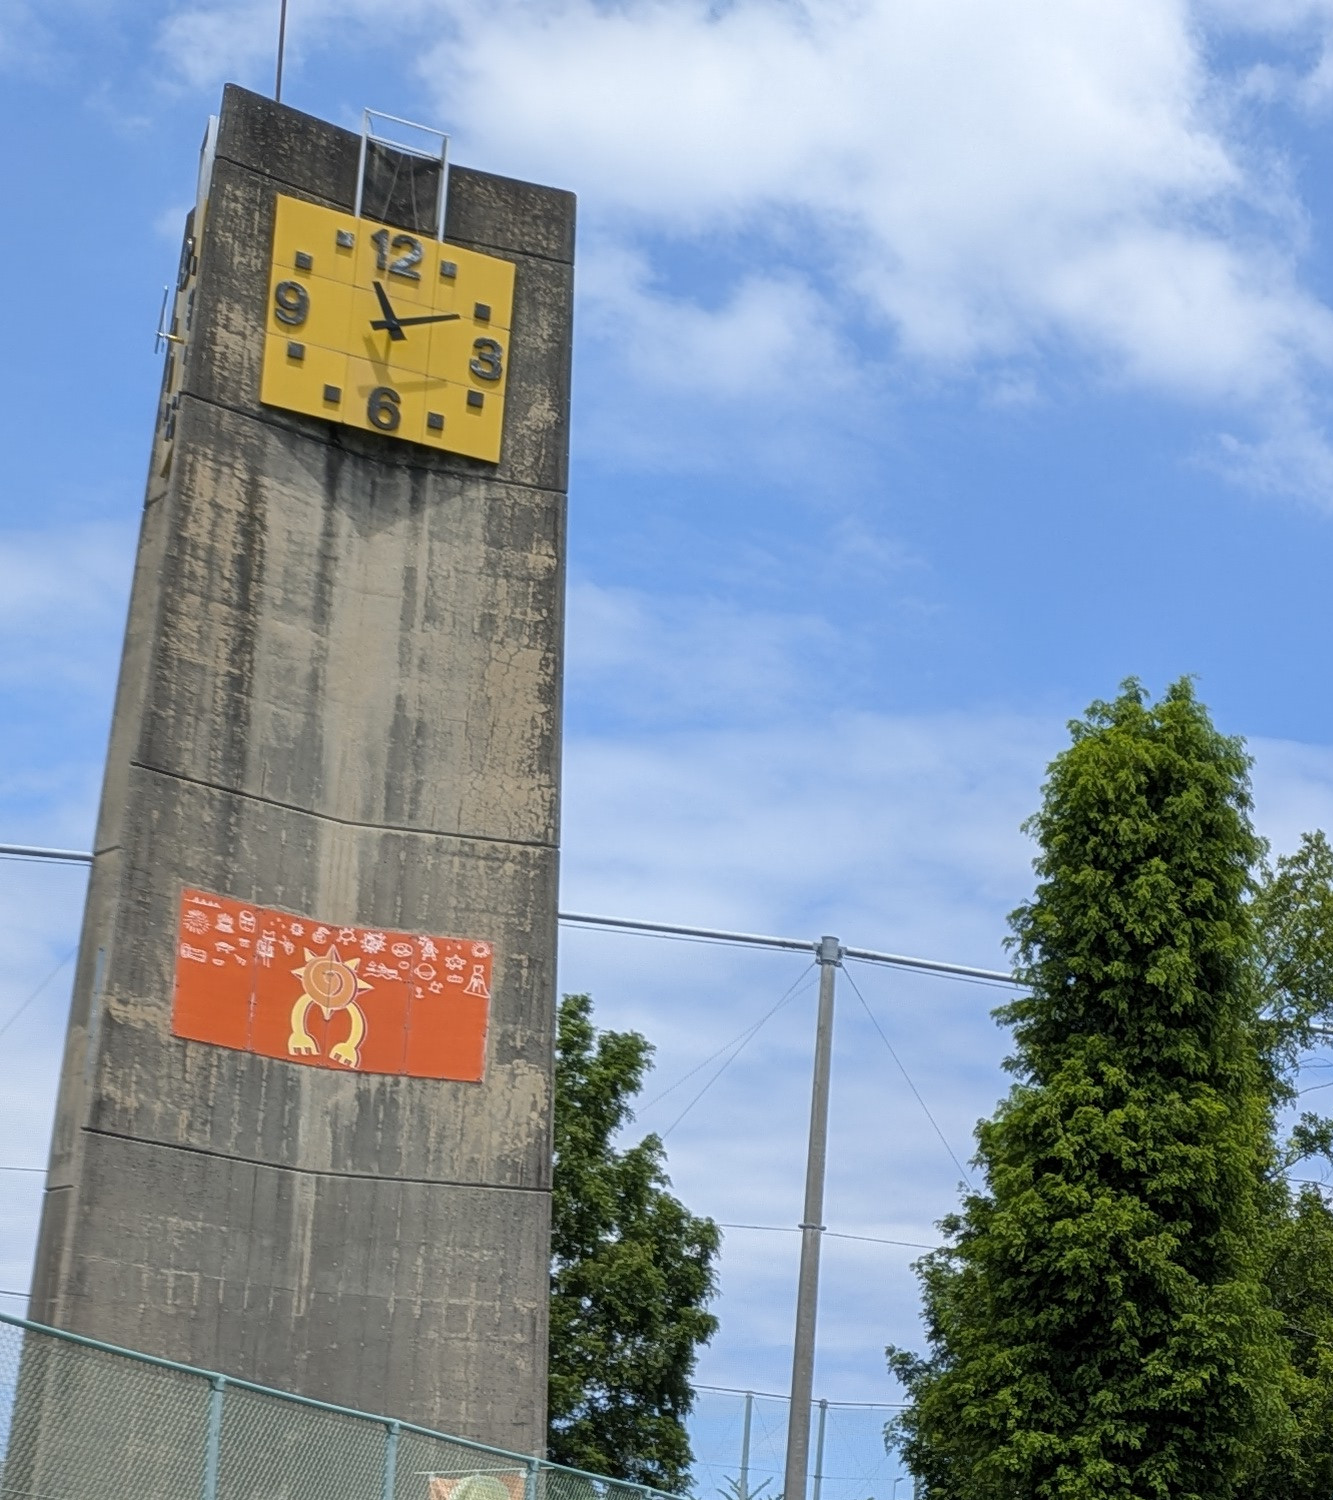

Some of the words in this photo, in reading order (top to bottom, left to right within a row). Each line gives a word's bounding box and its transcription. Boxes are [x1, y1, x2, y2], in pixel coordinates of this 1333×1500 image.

[371, 228, 423, 281] 12
[275, 280, 310, 327] 9
[469, 337, 504, 381] 3
[367, 386, 402, 431] 6
